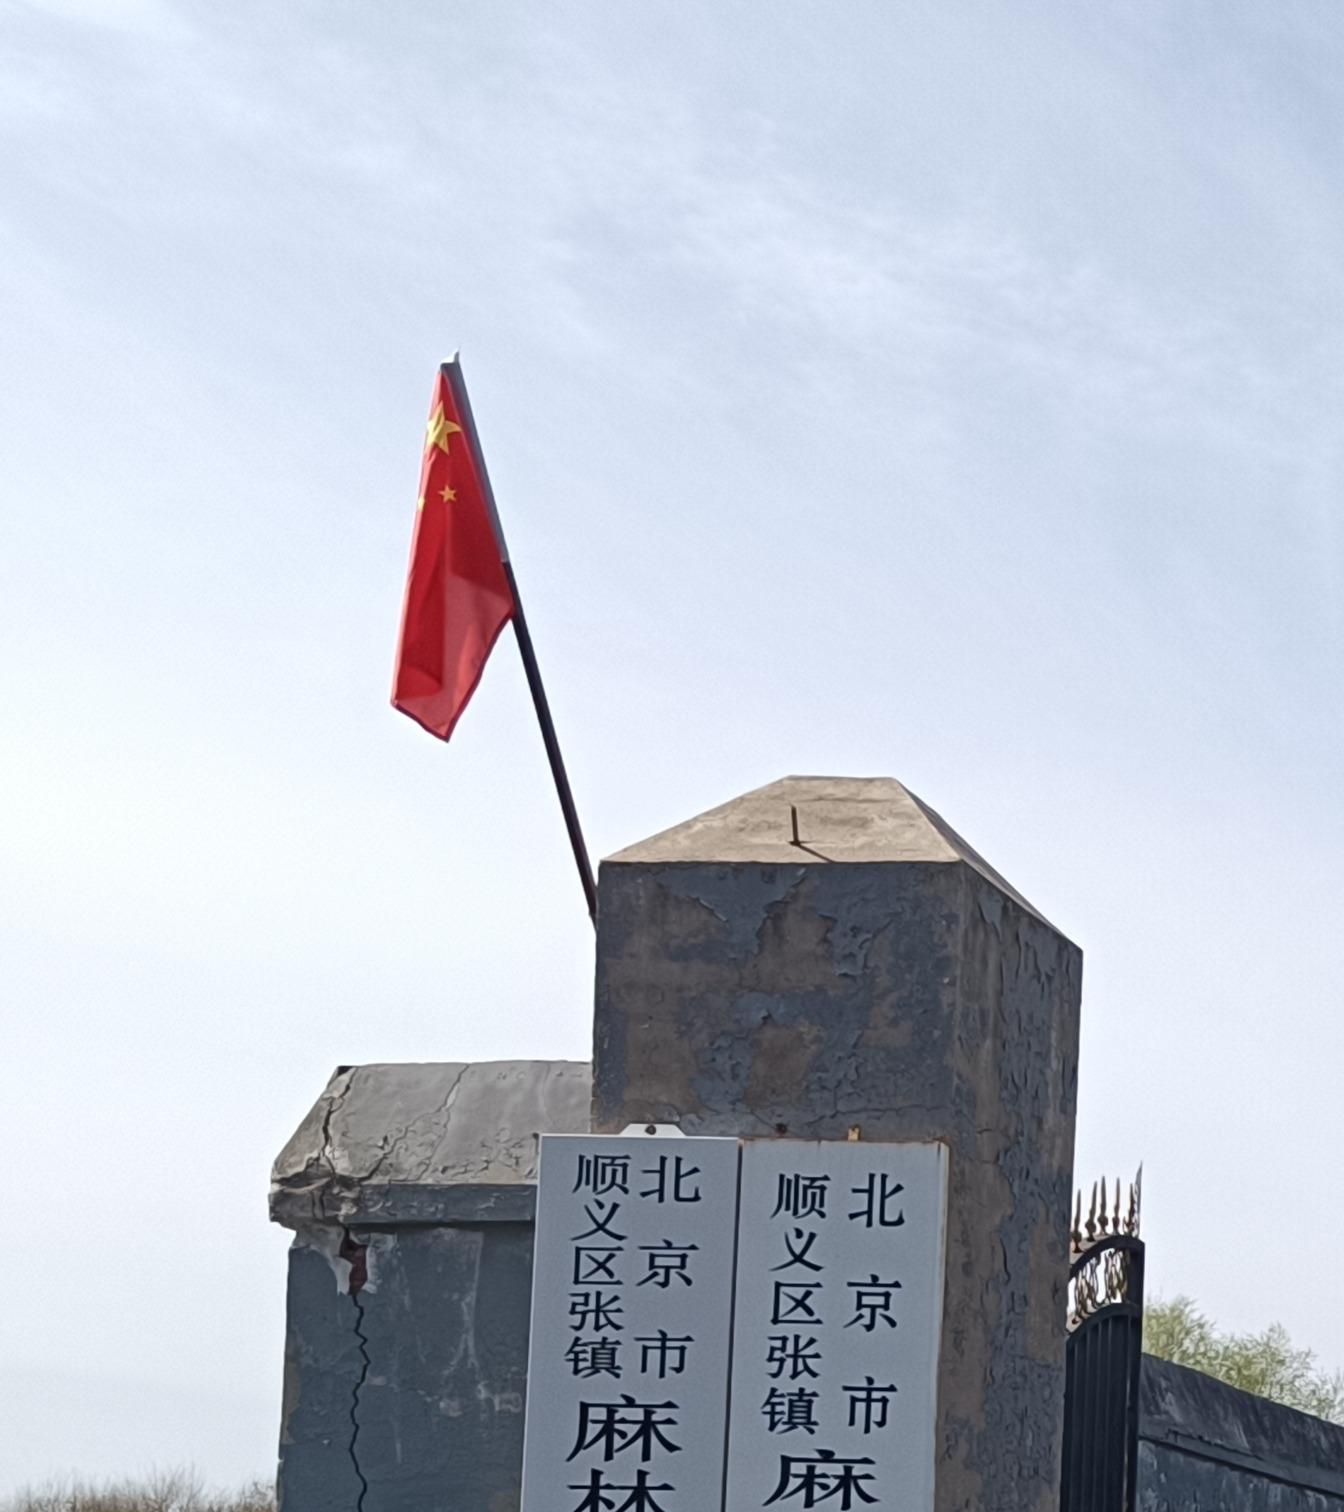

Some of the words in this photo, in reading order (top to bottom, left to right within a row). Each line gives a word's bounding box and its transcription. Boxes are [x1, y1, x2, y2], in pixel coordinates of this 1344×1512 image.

[564, 1154, 632, 1380] 顺义区张镇
[633, 1155, 701, 1380] 北京市
[761, 1172, 832, 1436] 顺义区张镇
[842, 1172, 906, 1435] 北京市
